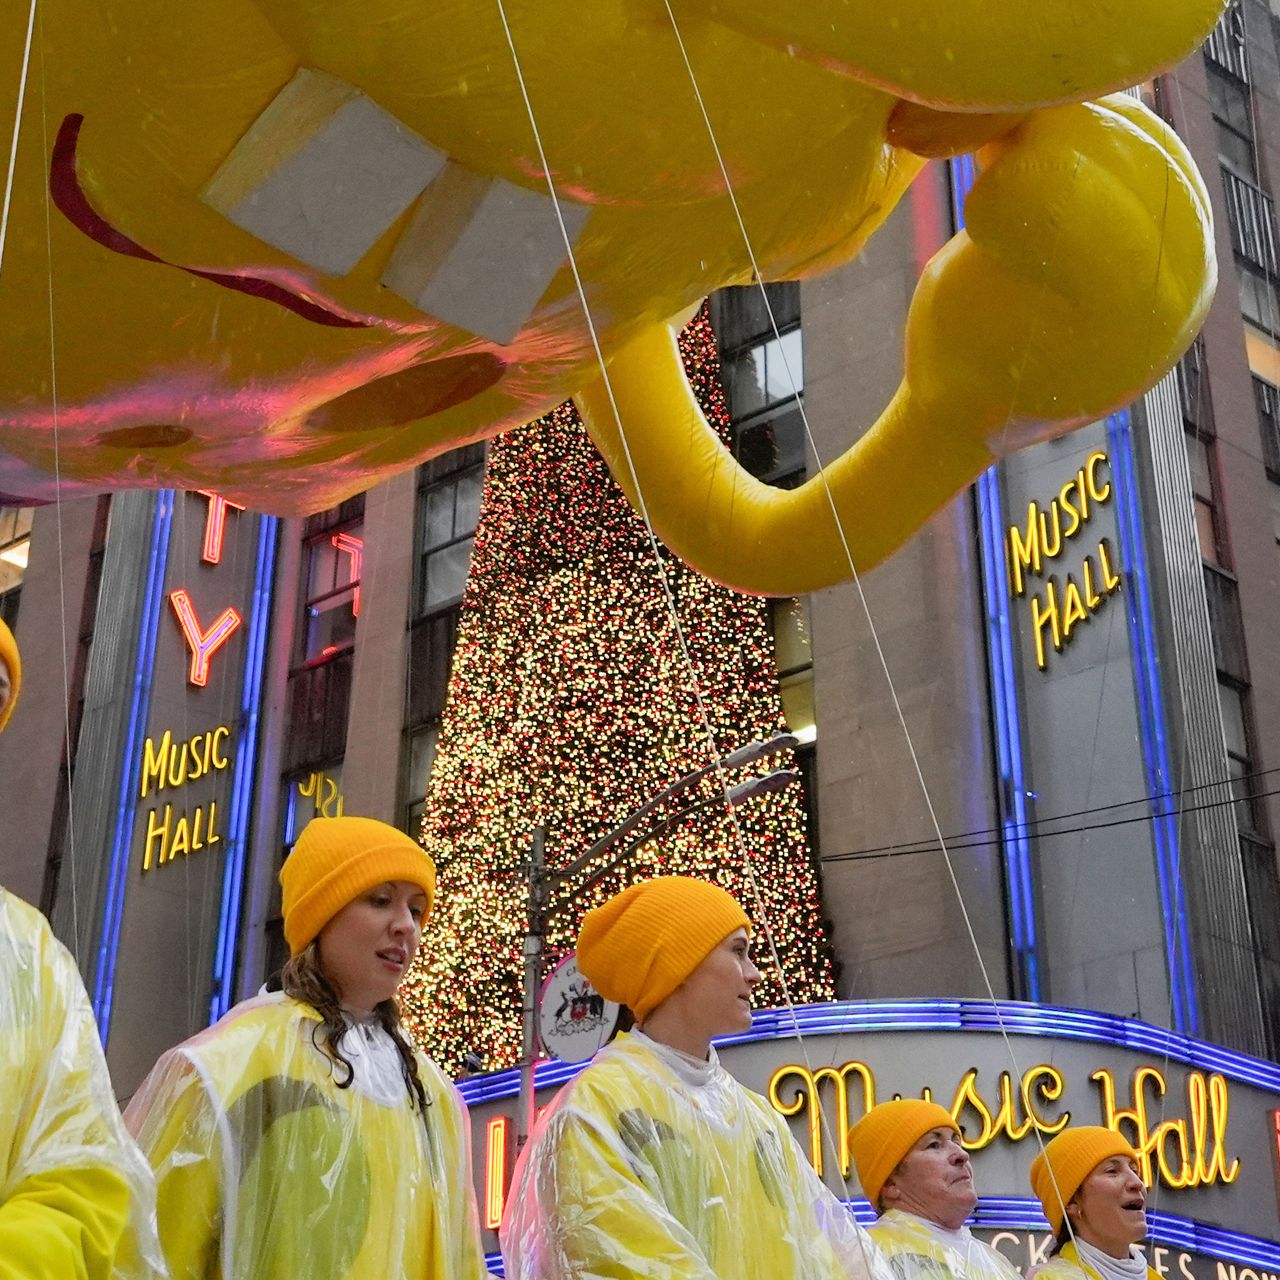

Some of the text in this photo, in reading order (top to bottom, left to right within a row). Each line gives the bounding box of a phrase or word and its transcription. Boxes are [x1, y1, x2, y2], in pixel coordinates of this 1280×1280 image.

[1009, 451, 1110, 593] MUSIC
[1031, 543, 1119, 669] HALL
[141, 726, 230, 798] MUSIC
[143, 802, 220, 870] HALL
[769, 1061, 1240, 1189] Msic Hall
